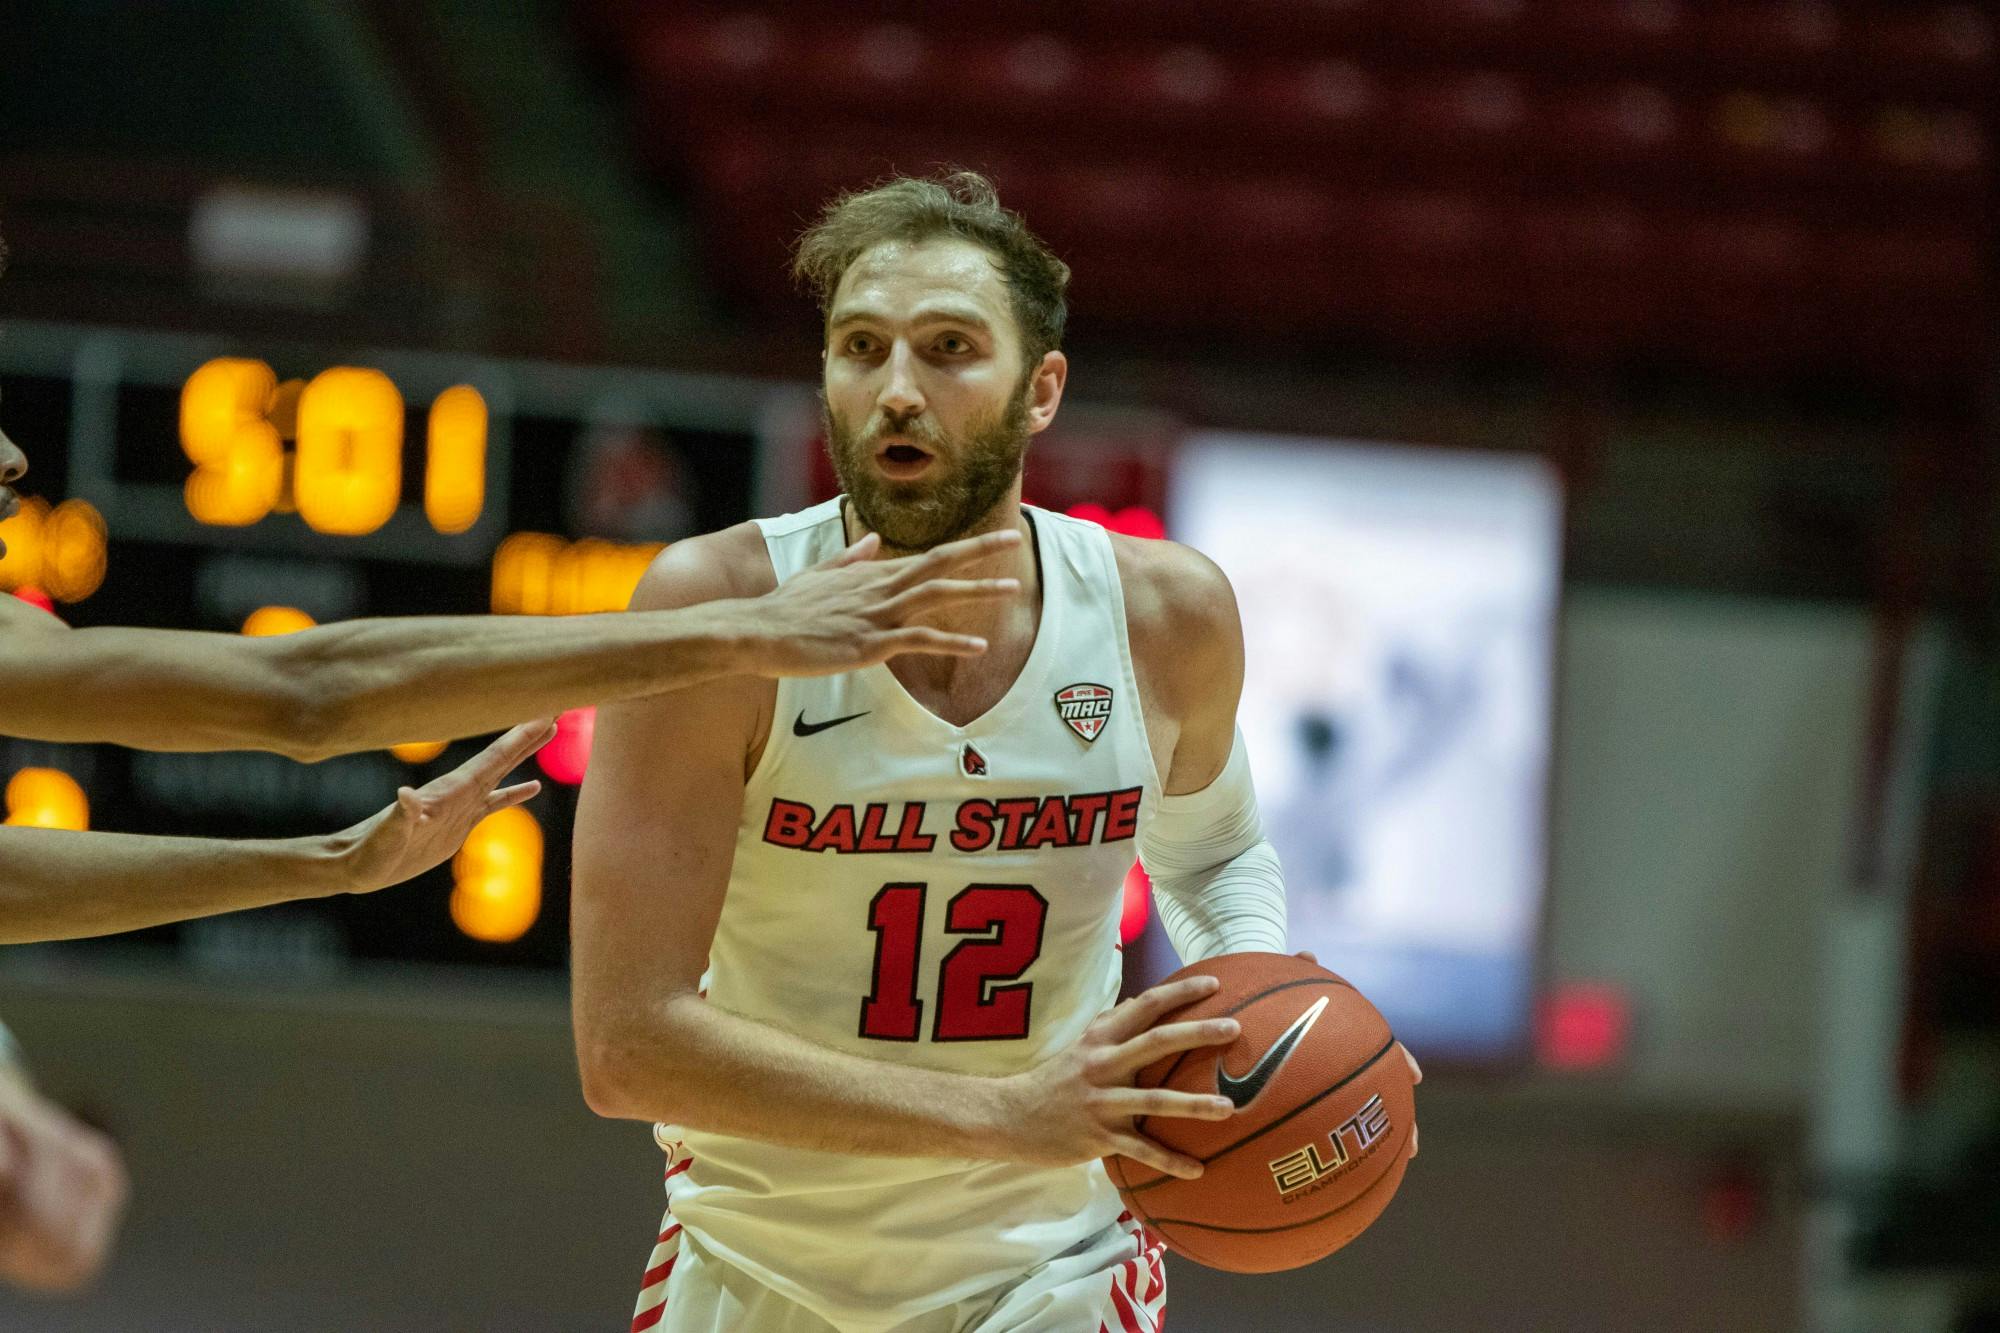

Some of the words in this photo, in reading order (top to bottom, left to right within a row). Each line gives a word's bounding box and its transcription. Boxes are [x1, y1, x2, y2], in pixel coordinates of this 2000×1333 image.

[1060, 699, 1111, 719] MAC
[762, 797, 937, 854] BALL
[949, 785, 1143, 853] STATE
[858, 882, 1049, 1042] 12
[1268, 1093, 1391, 1195] ELITE
